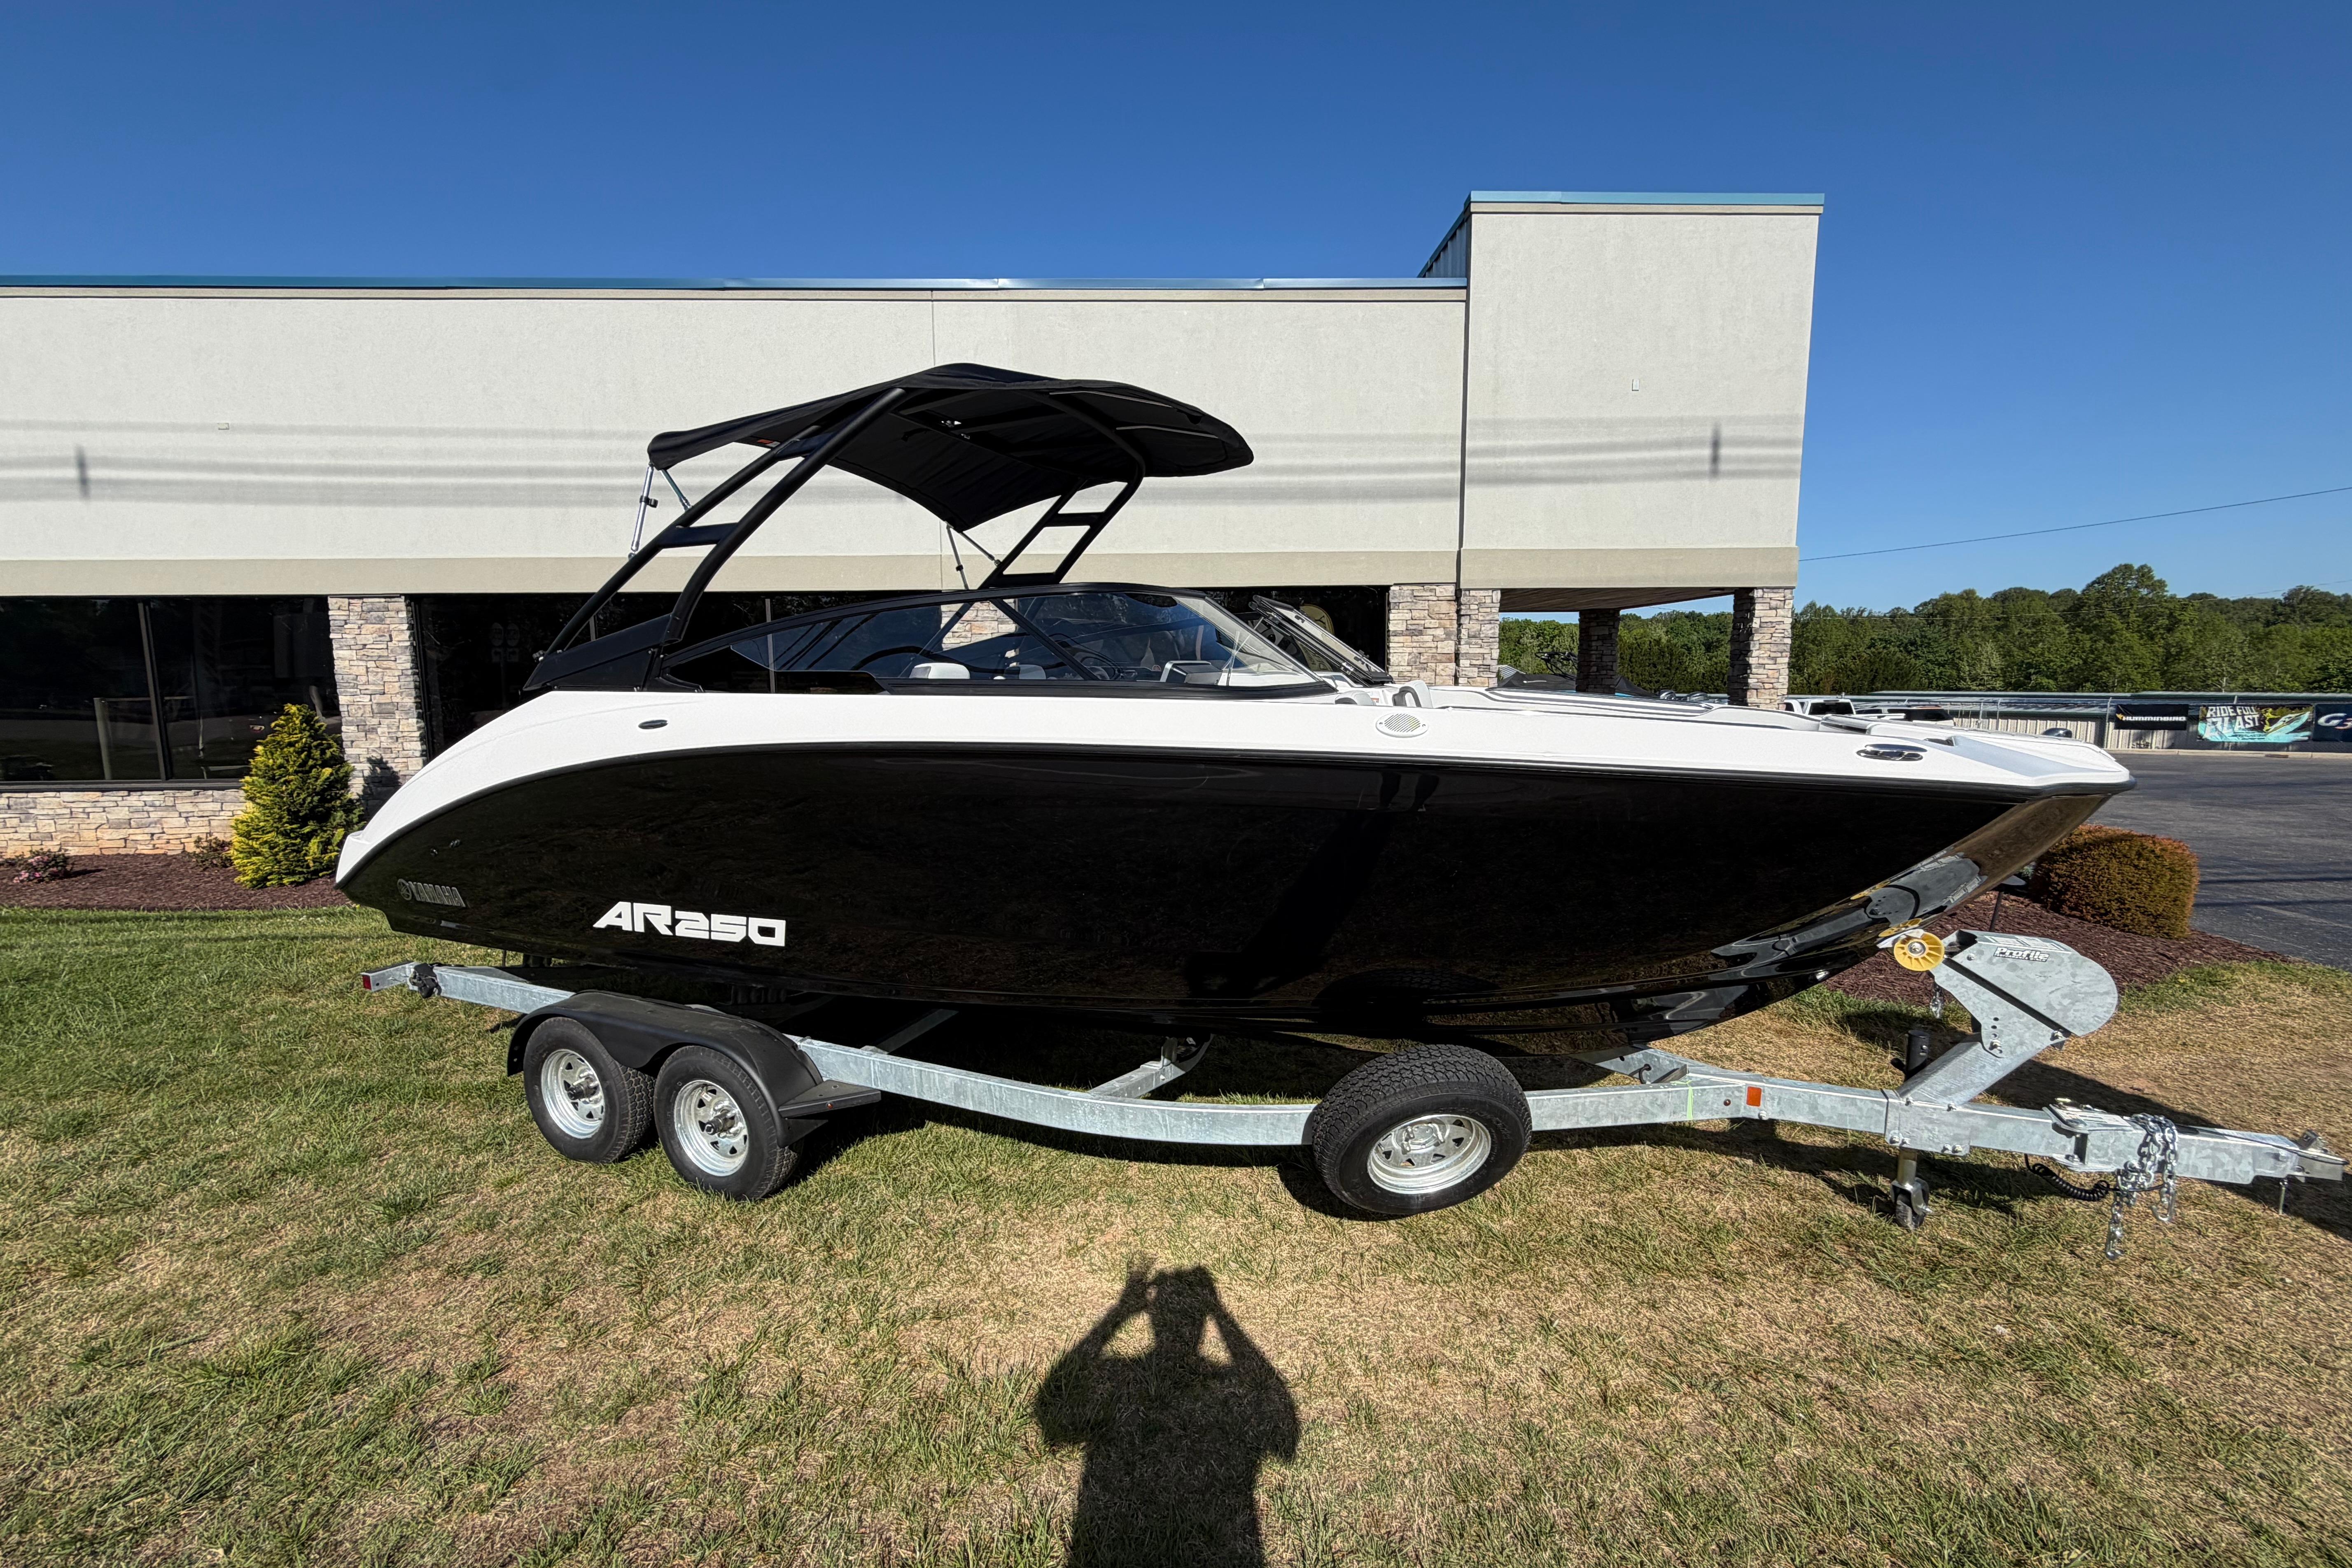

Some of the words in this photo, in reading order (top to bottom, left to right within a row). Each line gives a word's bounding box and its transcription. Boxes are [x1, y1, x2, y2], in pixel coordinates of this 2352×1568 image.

[2206, 706, 2237, 717] RIDE
[2236, 706, 2258, 715] FULL
[2203, 714, 2260, 738] BLAST
[408, 881, 466, 908] YAMAHA
[593, 901, 786, 947] AR250
[1995, 947, 2049, 959] Profile
